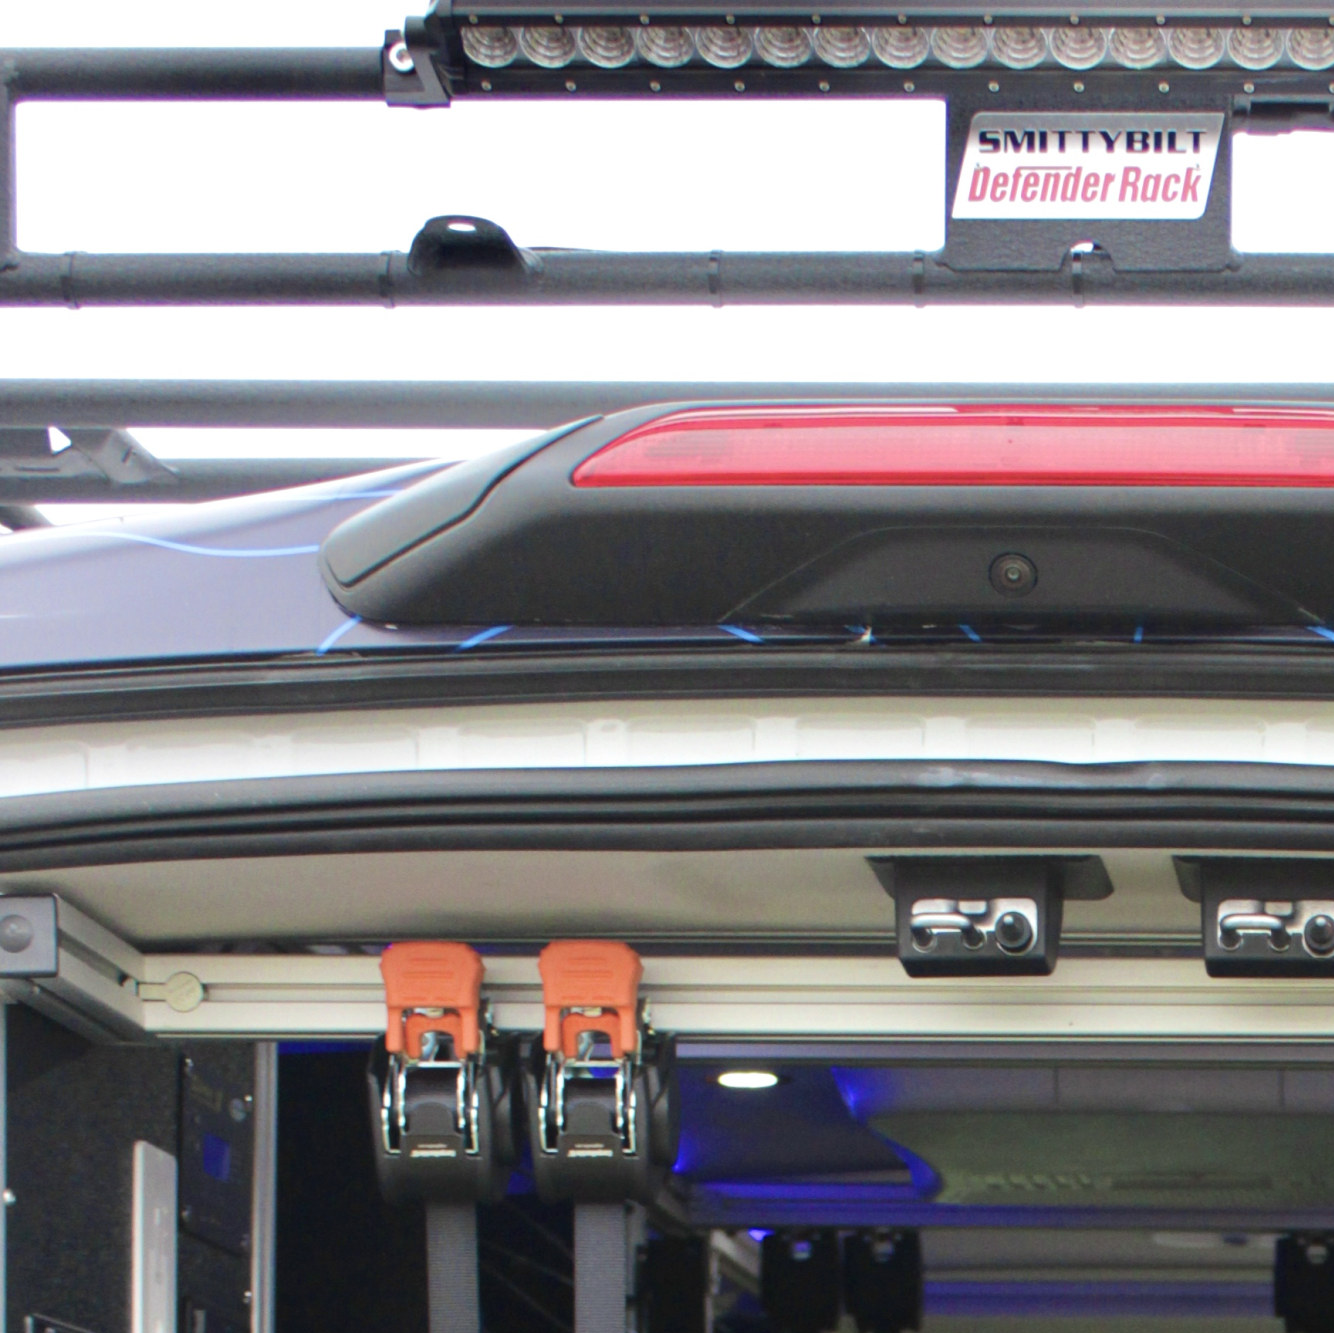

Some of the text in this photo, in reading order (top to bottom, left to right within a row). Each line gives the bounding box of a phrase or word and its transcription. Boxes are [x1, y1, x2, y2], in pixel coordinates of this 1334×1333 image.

[978, 130, 1206, 154] SMITTYBILT
[968, 165, 1202, 202] Defender Rack
